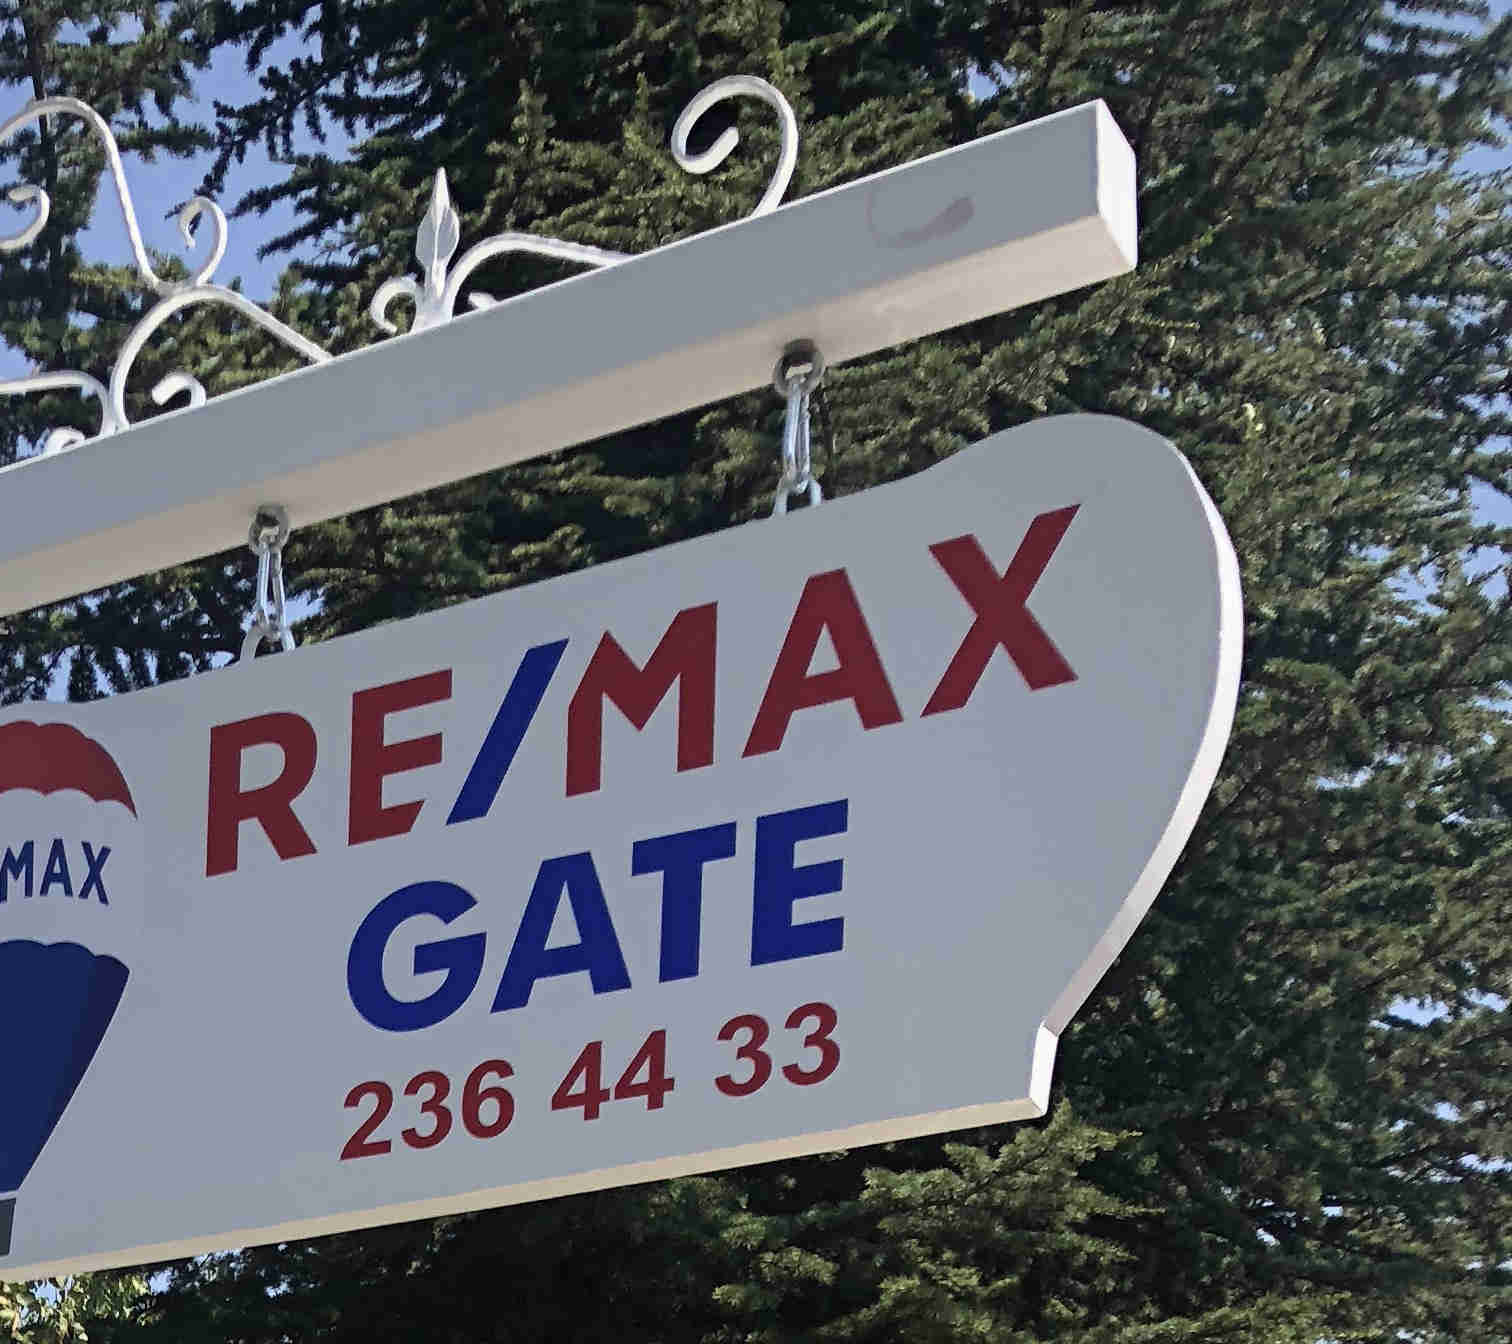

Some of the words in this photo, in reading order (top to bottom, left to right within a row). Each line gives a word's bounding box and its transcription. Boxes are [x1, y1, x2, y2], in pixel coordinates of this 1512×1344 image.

[204, 502, 1084, 878] RE/MAX
[344, 798, 850, 1034] GATE
[341, 1057, 517, 1162] 236
[550, 1030, 677, 1122] 44
[714, 1001, 843, 1099] 33
